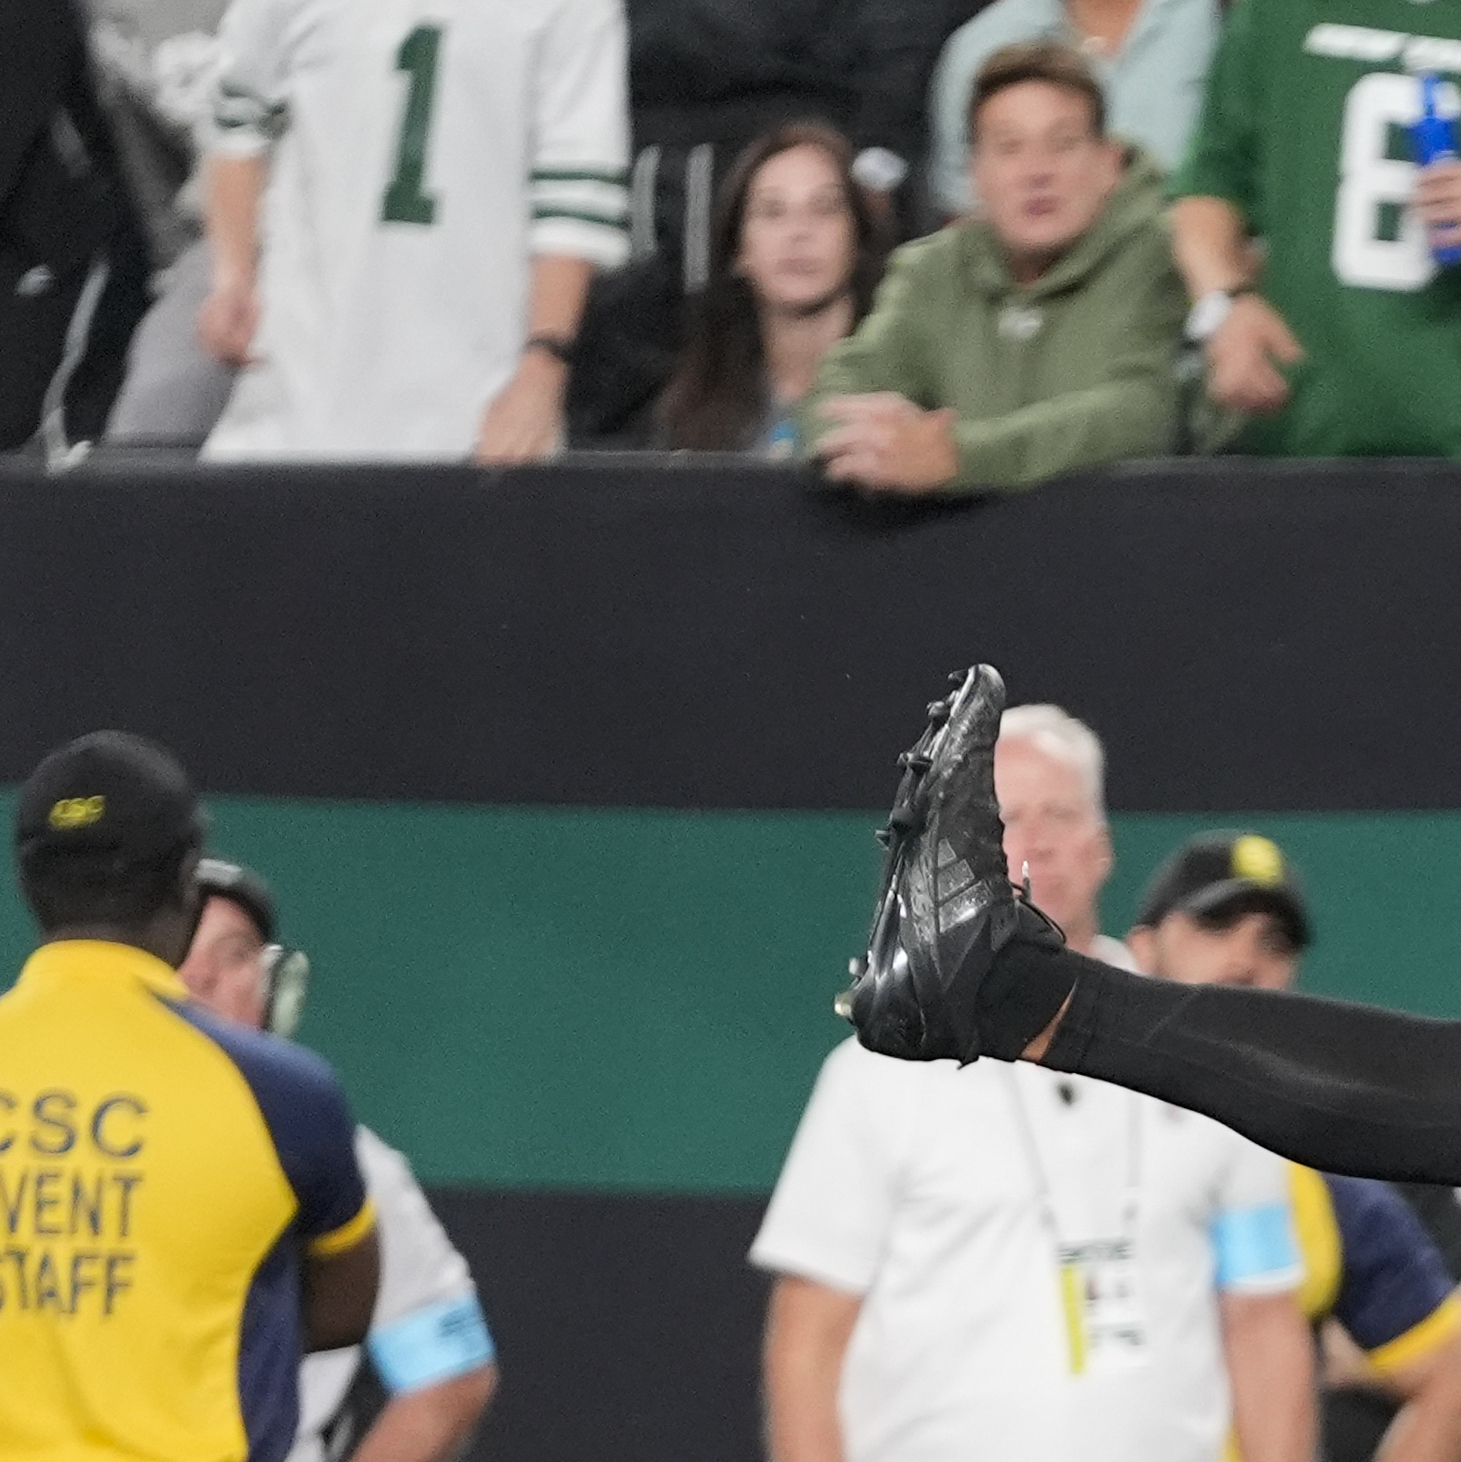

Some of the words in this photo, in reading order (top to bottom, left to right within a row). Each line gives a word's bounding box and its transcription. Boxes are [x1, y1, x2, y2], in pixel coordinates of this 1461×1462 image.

[380, 22, 443, 225] 1
[0, 1168, 145, 1238] VENT
[0, 1245, 135, 1316] TAFF
